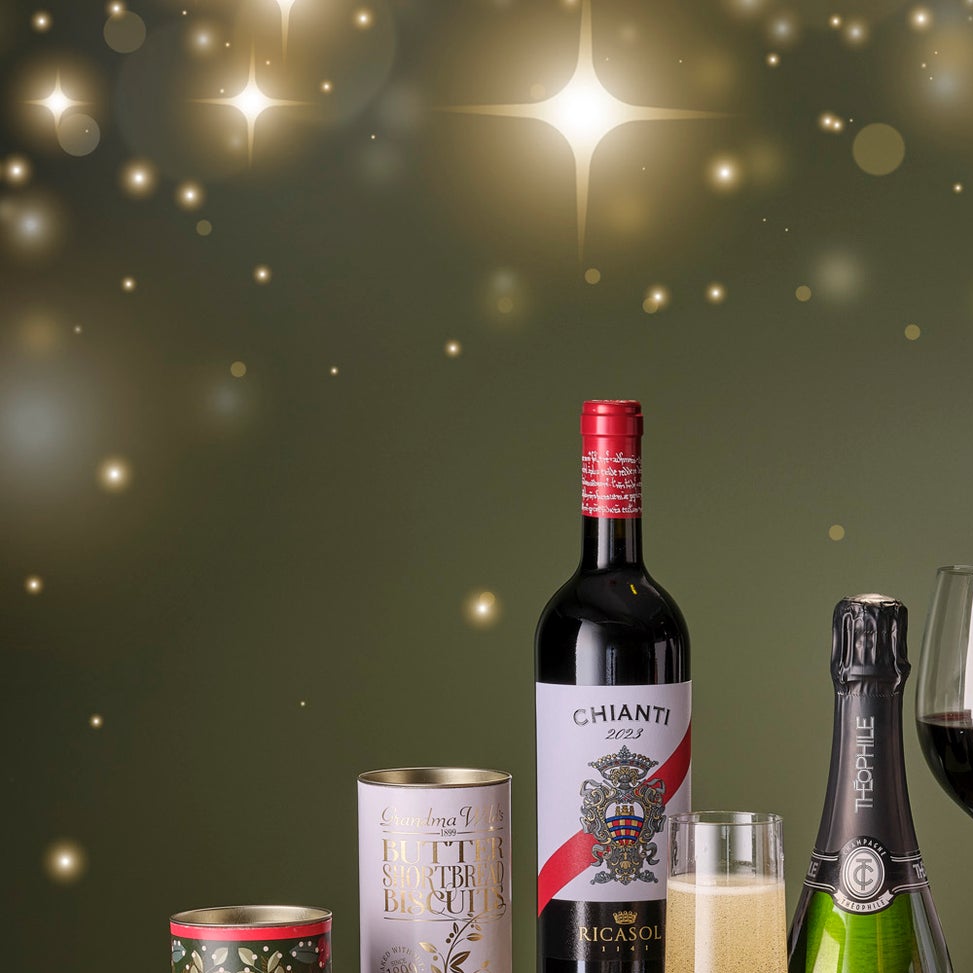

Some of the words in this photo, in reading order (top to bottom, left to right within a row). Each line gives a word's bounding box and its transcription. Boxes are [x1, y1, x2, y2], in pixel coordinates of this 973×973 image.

[573, 704, 671, 726] CHIANTI
[605, 728, 643, 740] 2023
[854, 716, 875, 813] THÉOPHILE
[440, 828, 457, 837] 1899
[382, 836, 503, 864] BUTTER
[382, 861, 505, 889] SHORTBREAD
[384, 885, 507, 914] BISCUITS
[579, 925, 662, 942] RICASOL
